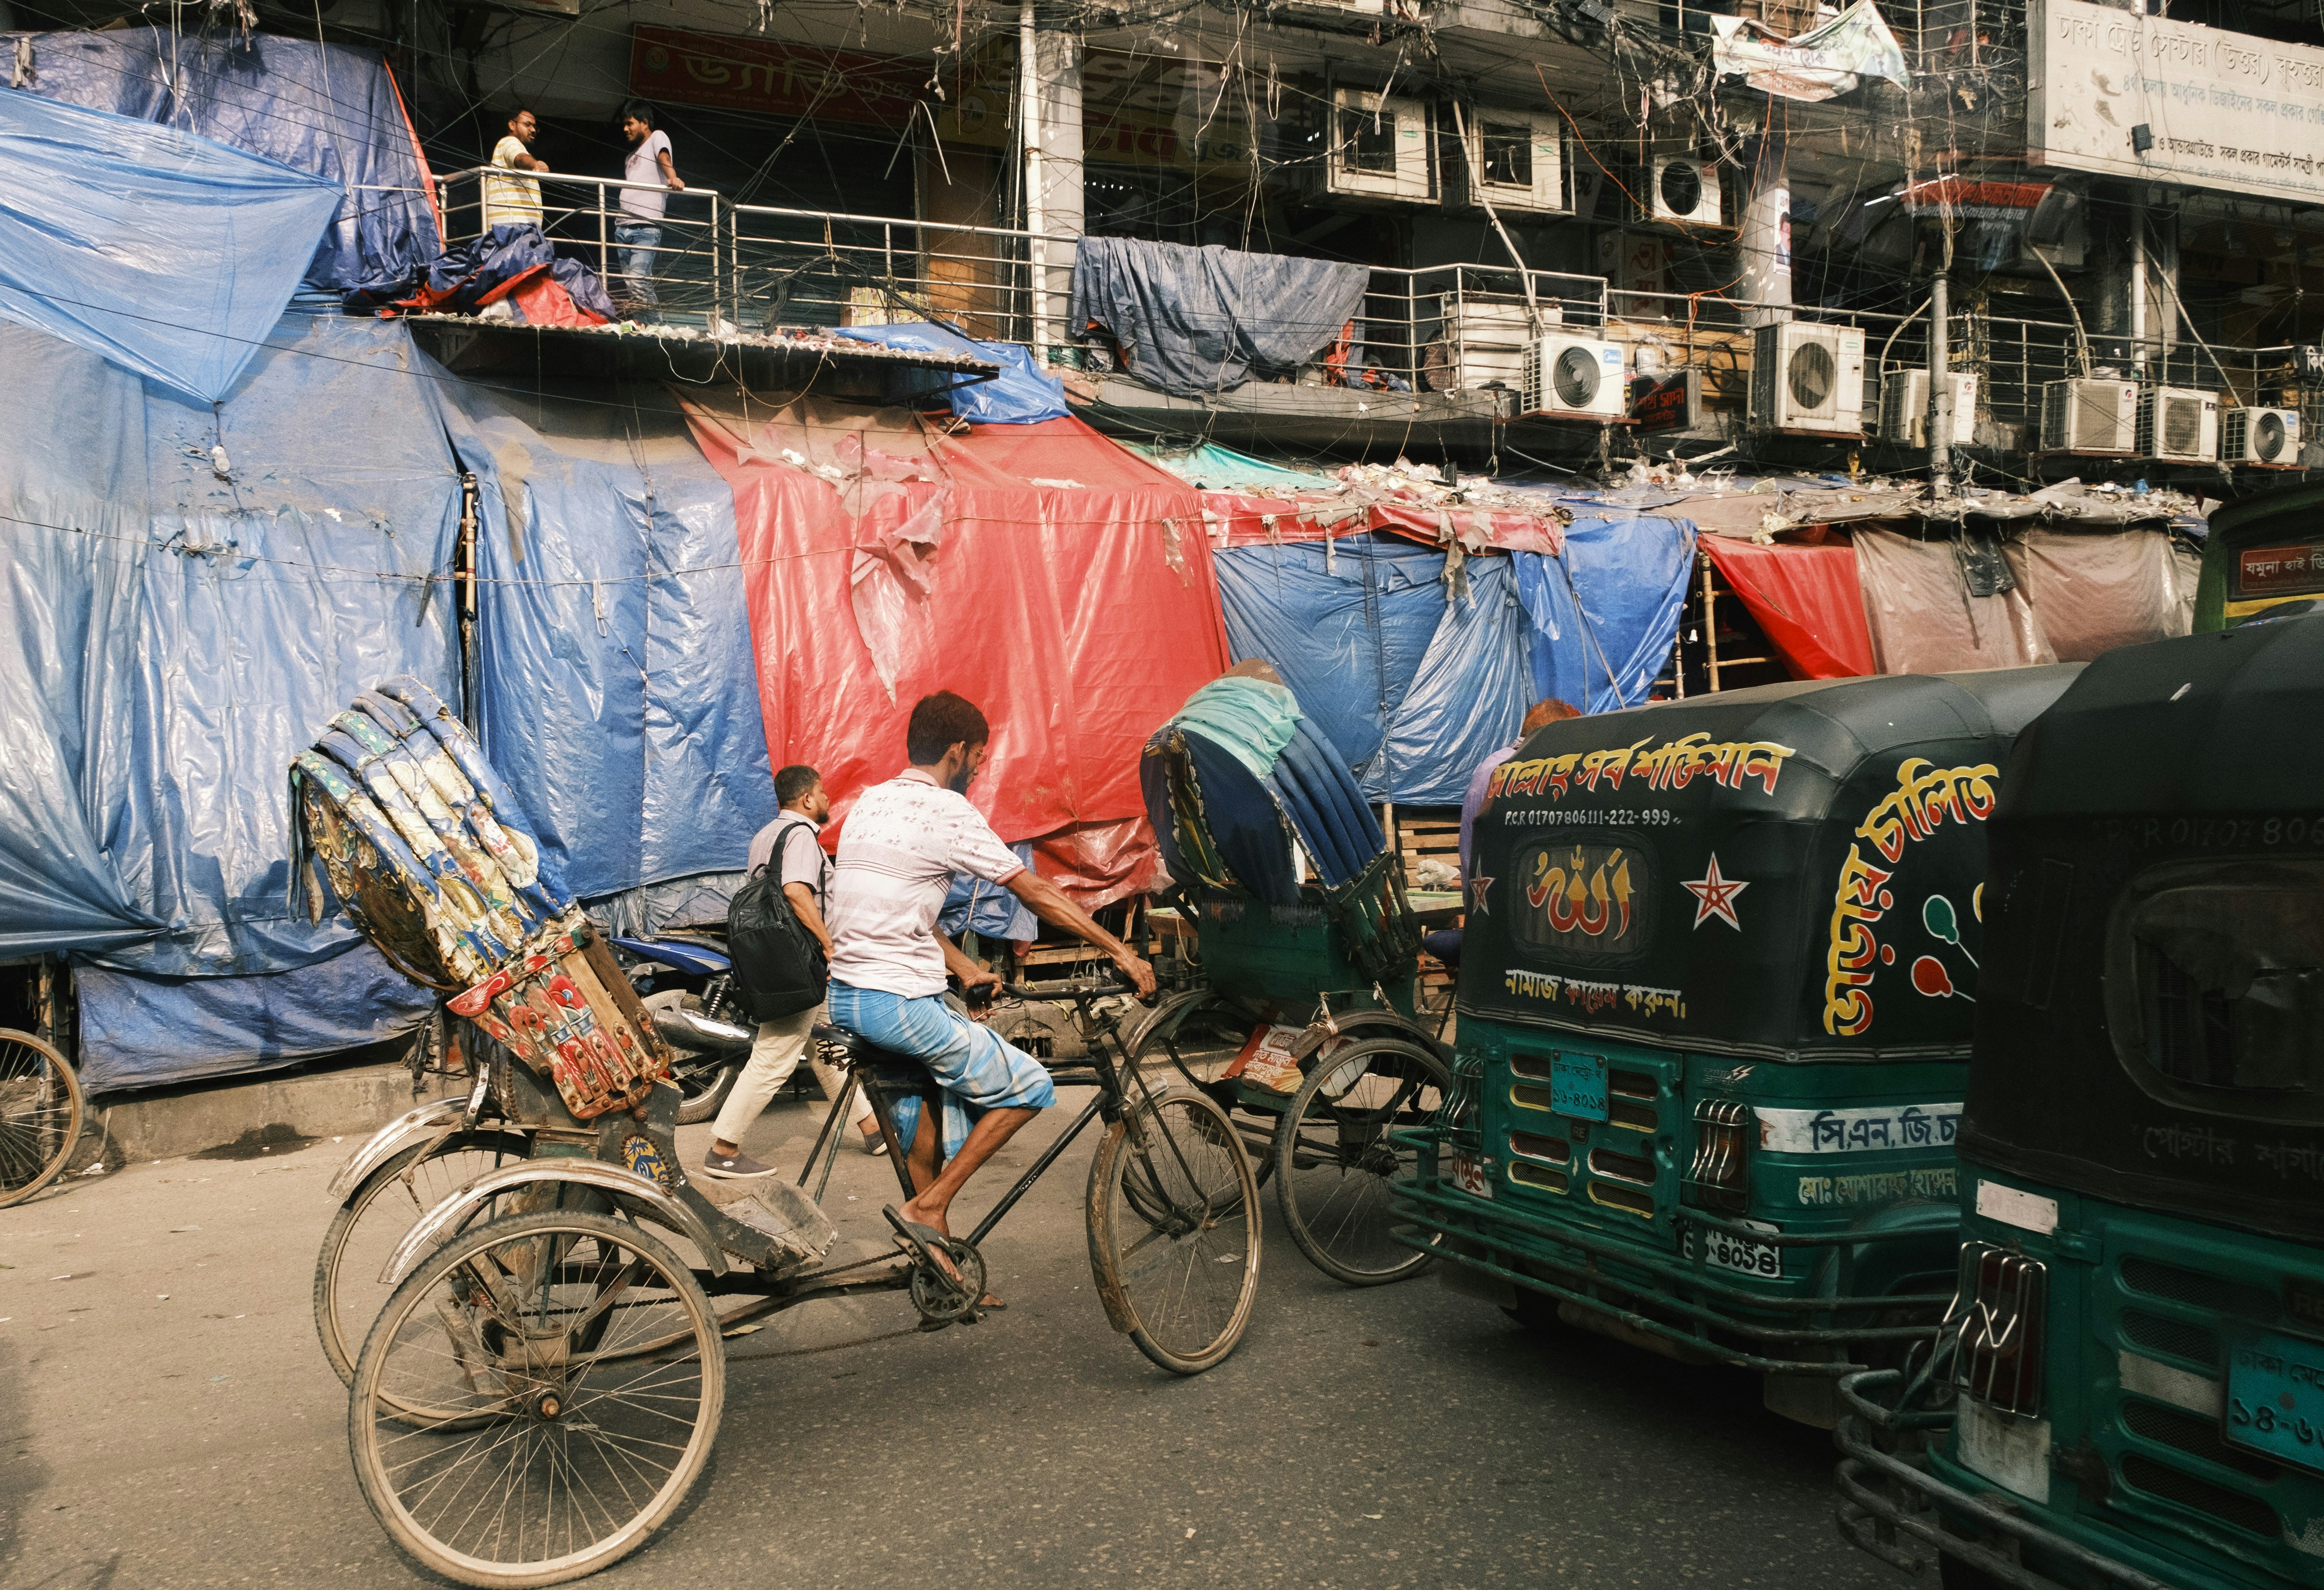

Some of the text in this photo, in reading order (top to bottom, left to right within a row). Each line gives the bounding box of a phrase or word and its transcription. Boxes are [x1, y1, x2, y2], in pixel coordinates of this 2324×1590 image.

[2055, 12, 2099, 49] ঢাকা
[2151, 28, 2207, 67] সেন্টার
[2256, 98, 2278, 117] সকল
[2219, 146, 2237, 163] সকল
[2244, 559, 2280, 578] যমুনা
[1855, 757, 2000, 863] চালিত
[1505, 969, 1562, 1001] নামাজ
[1564, 977, 1620, 1015] কায়েম
[1573, 1125, 1586, 1140] RE
